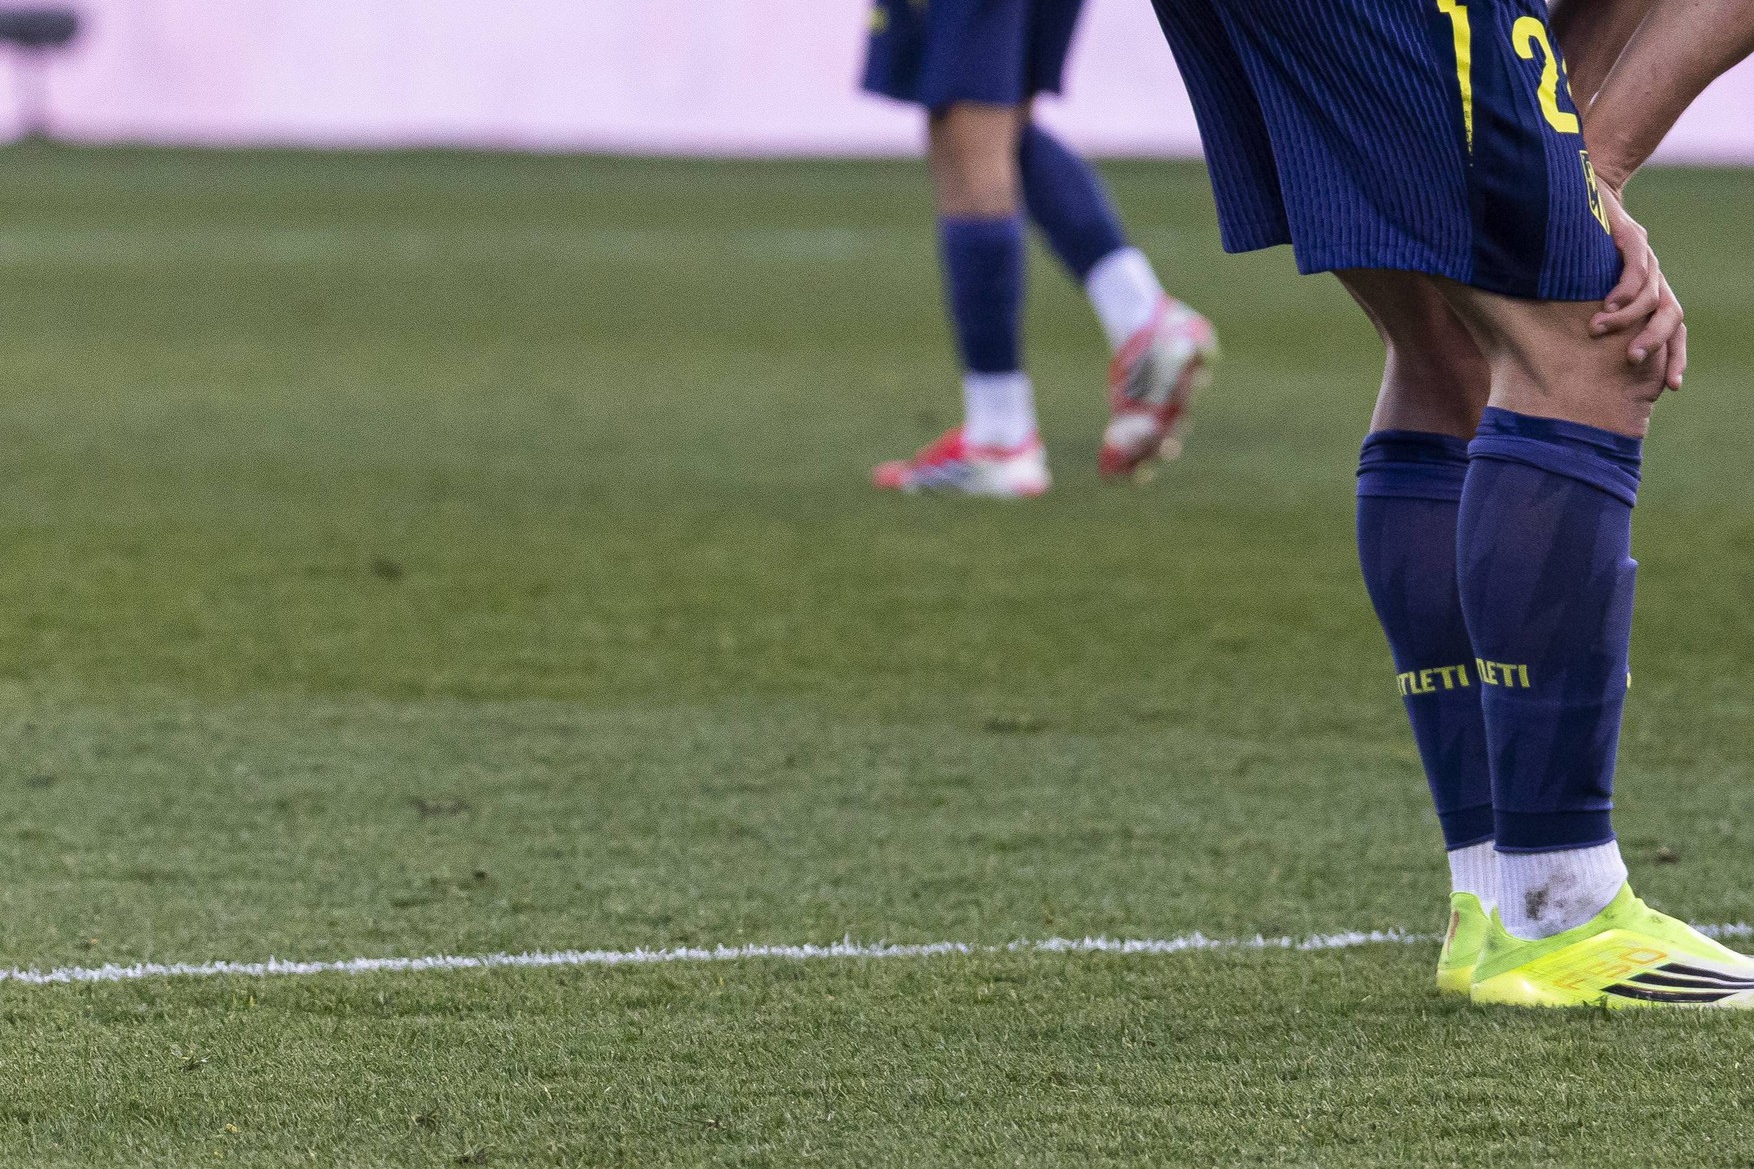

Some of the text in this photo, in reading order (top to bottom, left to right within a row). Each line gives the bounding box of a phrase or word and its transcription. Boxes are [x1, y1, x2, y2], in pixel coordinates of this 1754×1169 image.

[1512, 15, 1580, 134] 2
[1396, 664, 1470, 696] TLETI
[1476, 657, 1530, 688] LETI
